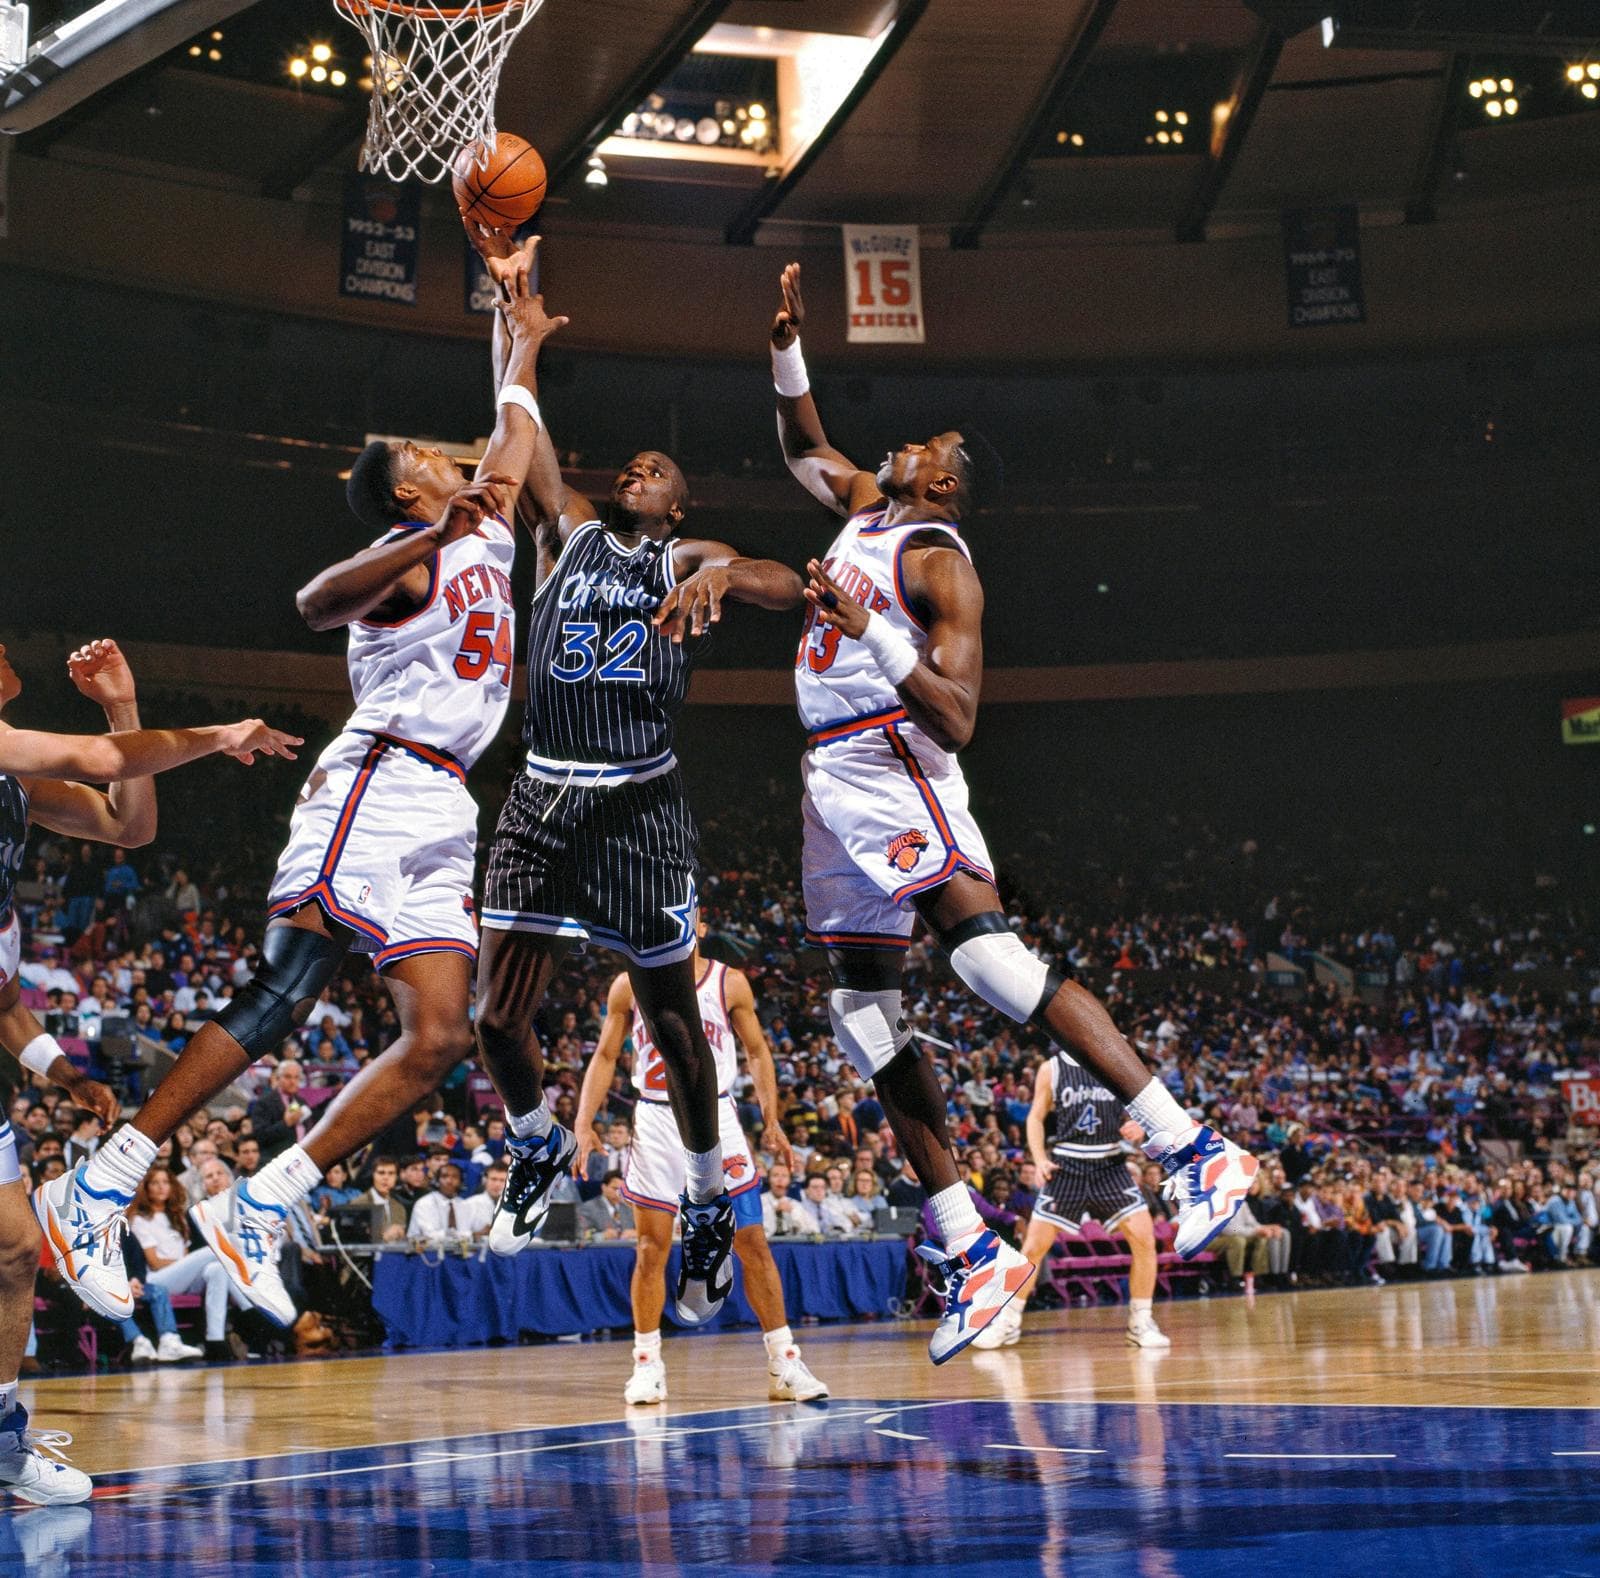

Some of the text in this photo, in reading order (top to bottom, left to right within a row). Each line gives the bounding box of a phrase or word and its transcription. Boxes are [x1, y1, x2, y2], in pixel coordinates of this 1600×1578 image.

[365, 241, 397, 259] EAST
[855, 259, 912, 306] 15
[442, 563, 493, 624] NEW
[453, 610, 513, 687] 54
[550, 619, 648, 683] 32
[643, 1046, 668, 1091] 2
[1075, 1103, 1102, 1135] 4
